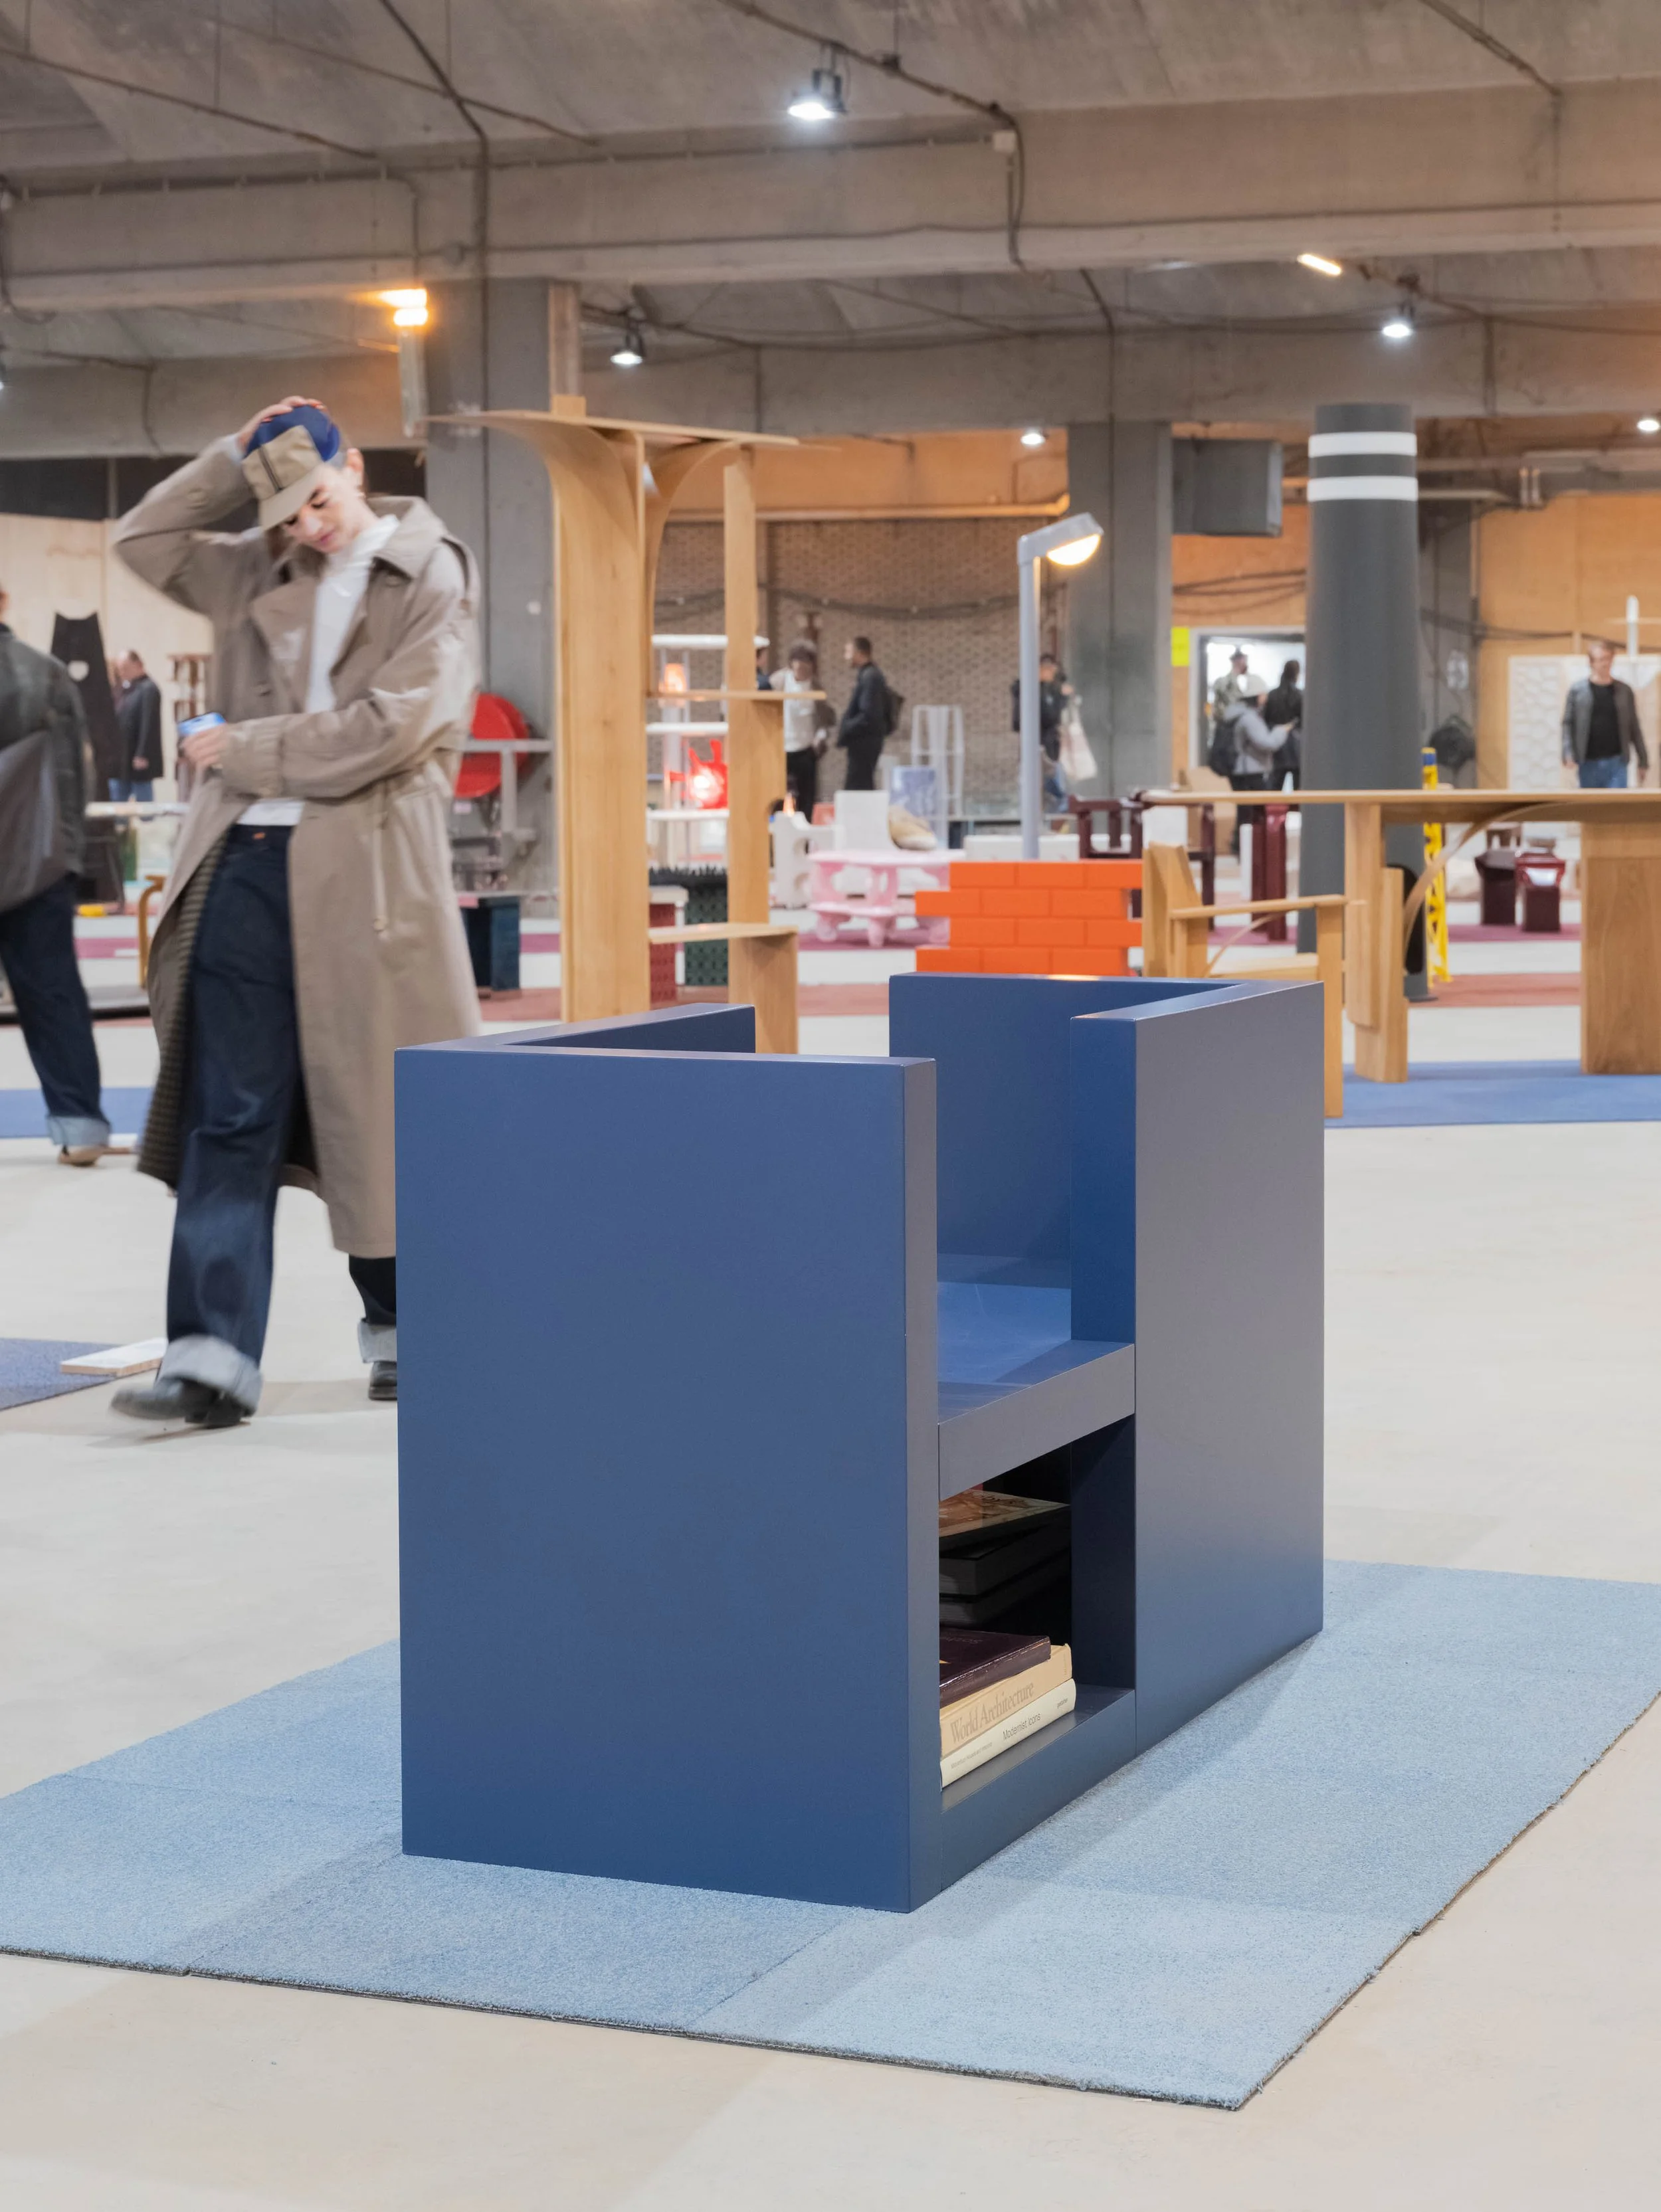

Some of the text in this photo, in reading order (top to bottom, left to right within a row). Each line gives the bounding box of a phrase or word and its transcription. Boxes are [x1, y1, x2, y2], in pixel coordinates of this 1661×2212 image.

[950, 1682, 1034, 1744] World Architecture
[1003, 1713, 1041, 1740] Modernist Icons
